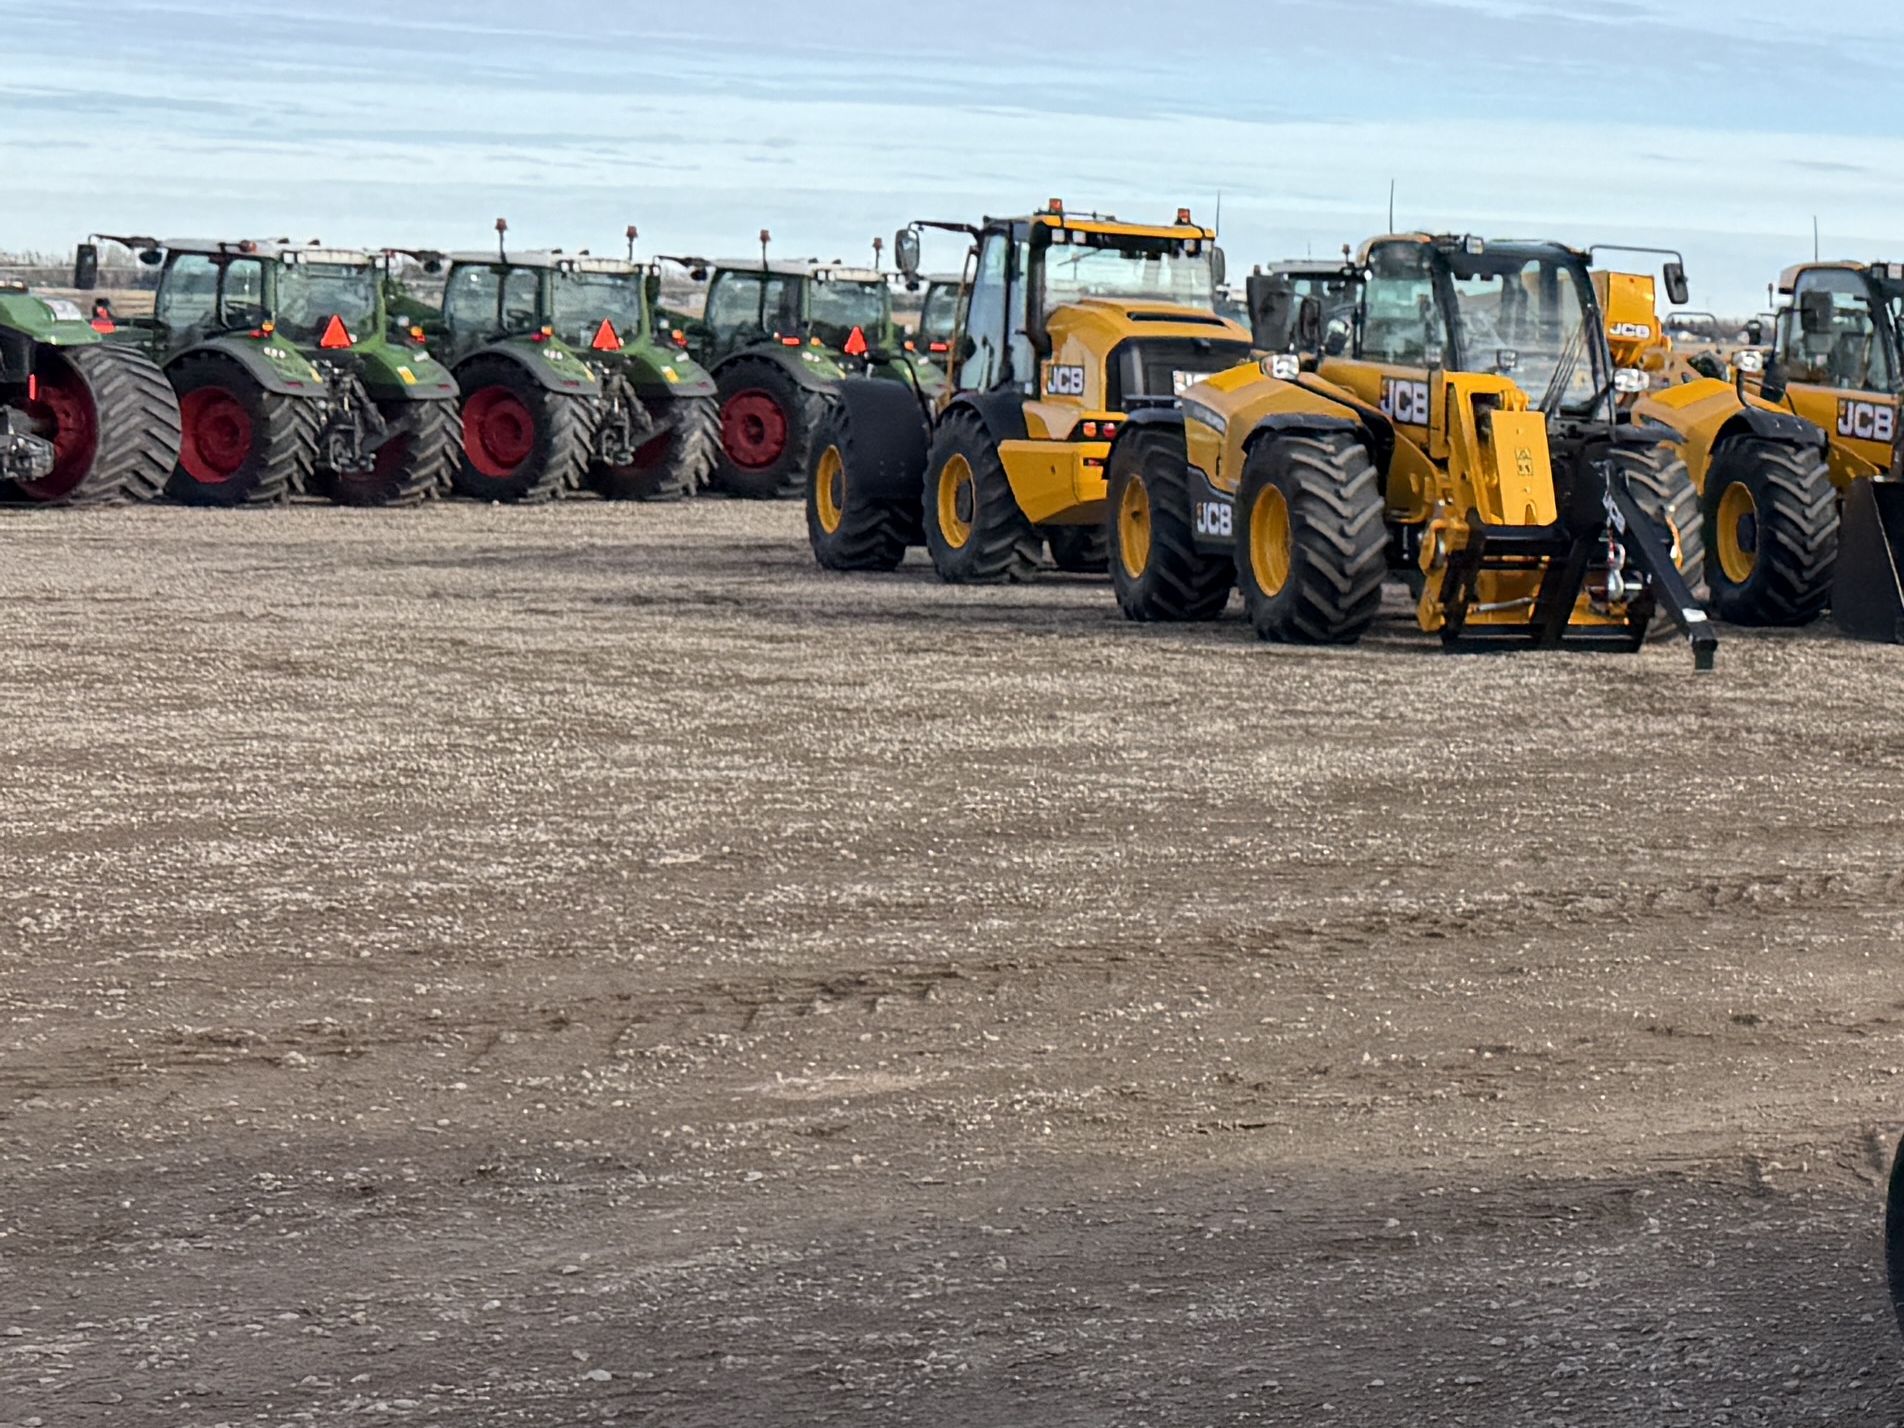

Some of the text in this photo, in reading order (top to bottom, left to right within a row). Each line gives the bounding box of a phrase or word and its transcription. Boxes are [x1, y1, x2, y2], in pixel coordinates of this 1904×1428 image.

[1608, 322, 1650, 339] JCB
[1047, 367, 1084, 395] JCB
[1380, 379, 1429, 424] JCB
[1837, 401, 1894, 441] JCB
[1197, 502, 1233, 537] JCB
